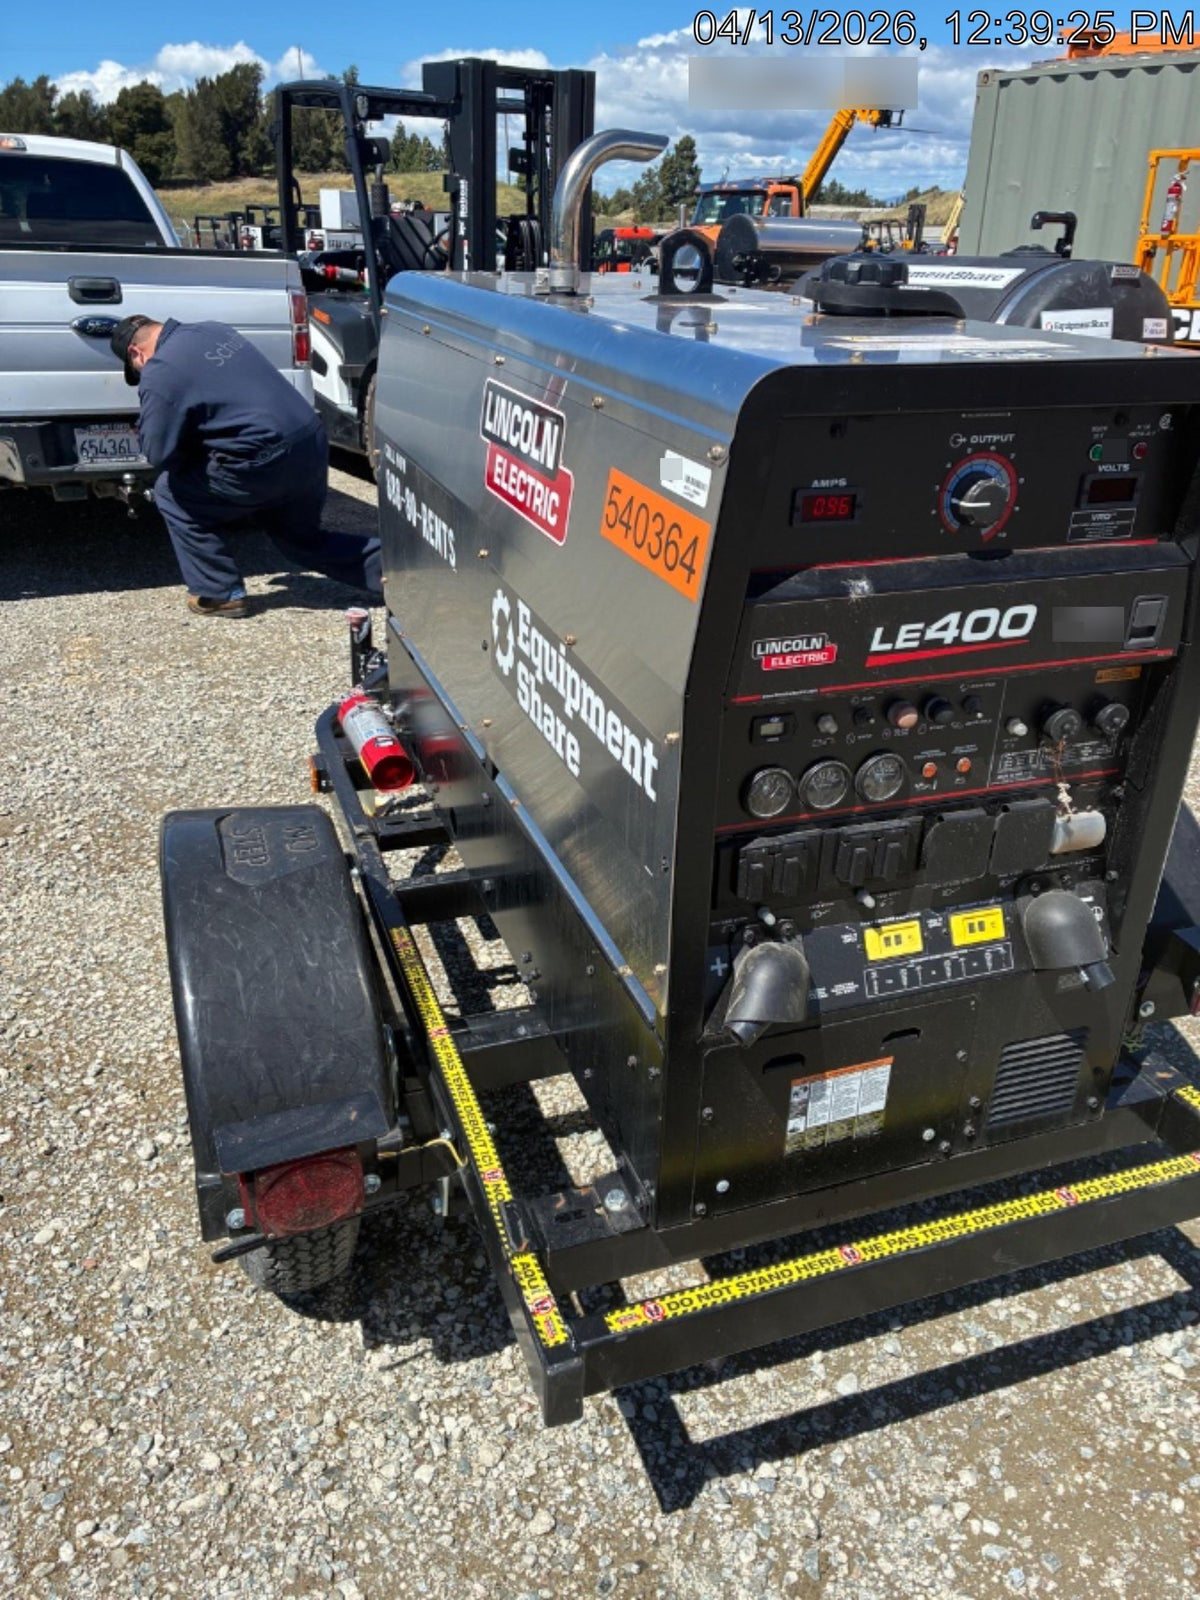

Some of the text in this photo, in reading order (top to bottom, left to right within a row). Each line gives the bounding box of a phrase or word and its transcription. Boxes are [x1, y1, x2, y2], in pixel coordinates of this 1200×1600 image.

[484, 391, 559, 470] LINCOLN
[970, 433, 1016, 443] OUTPUT
[812, 478, 848, 488] AMPS
[1098, 463, 1130, 472] VOLTS
[493, 454, 560, 526] ELECTRIC
[813, 497, 850, 516] 096
[605, 485, 699, 584] 540364
[756, 636, 823, 655] LINCOLN
[869, 604, 1037, 651] LE400
[771, 651, 828, 667] ELECTRIC
[517, 599, 658, 802] Equipment
[517, 660, 581, 777] Share
[231, 825, 271, 866] STEP
[283, 825, 319, 852] NO
[463, 1104, 488, 1153] DEBOUT
[1076, 1184, 1101, 1197] NO
[1103, 1177, 1122, 1190] SE
[1123, 1167, 1159, 1185] PARE
[862, 1196, 1057, 1256] NE PAS TENEZ DEBOUT ICI
[667, 1253, 840, 1312] DO NOT STAND HERE
